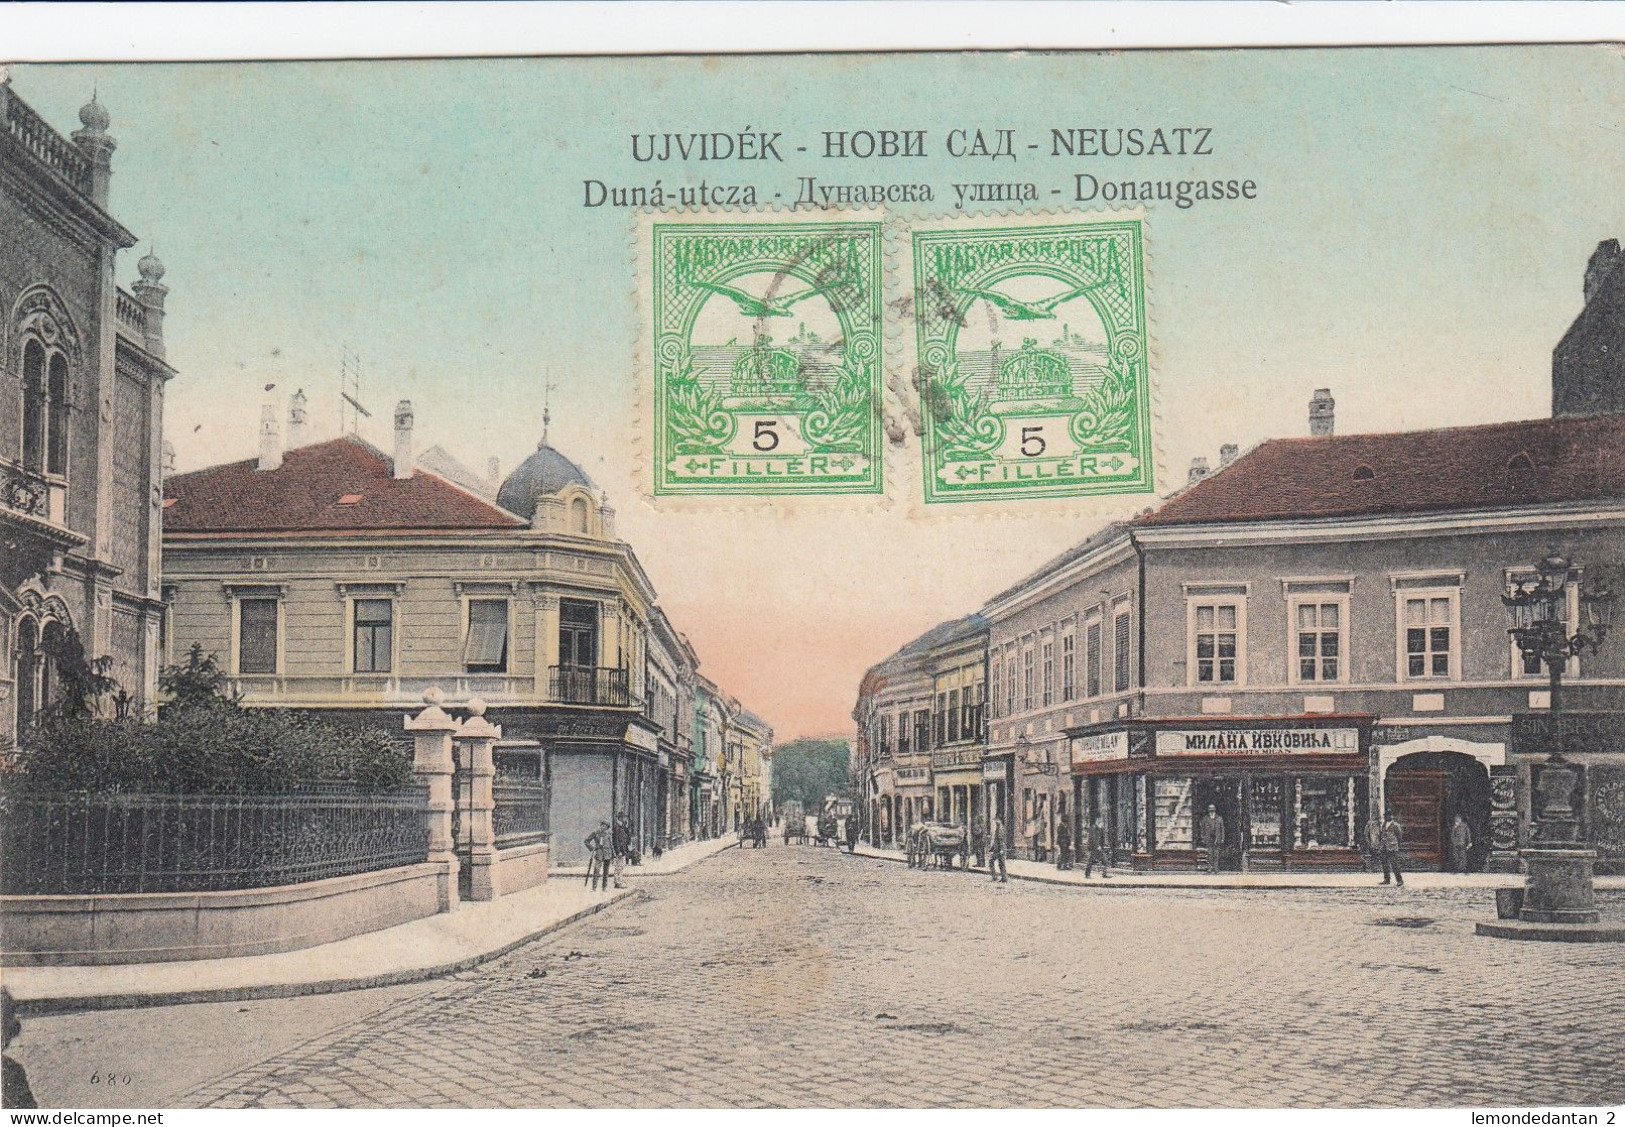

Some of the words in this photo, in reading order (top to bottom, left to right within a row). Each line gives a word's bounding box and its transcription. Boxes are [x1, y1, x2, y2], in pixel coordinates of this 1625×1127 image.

[752, 420, 779, 451] 5
[1020, 426, 1046, 457] 5
[709, 456, 830, 476] FILLÉR
[978, 458, 1099, 481] FILLÉR
[1185, 734, 1248, 750] МИЛАНА
